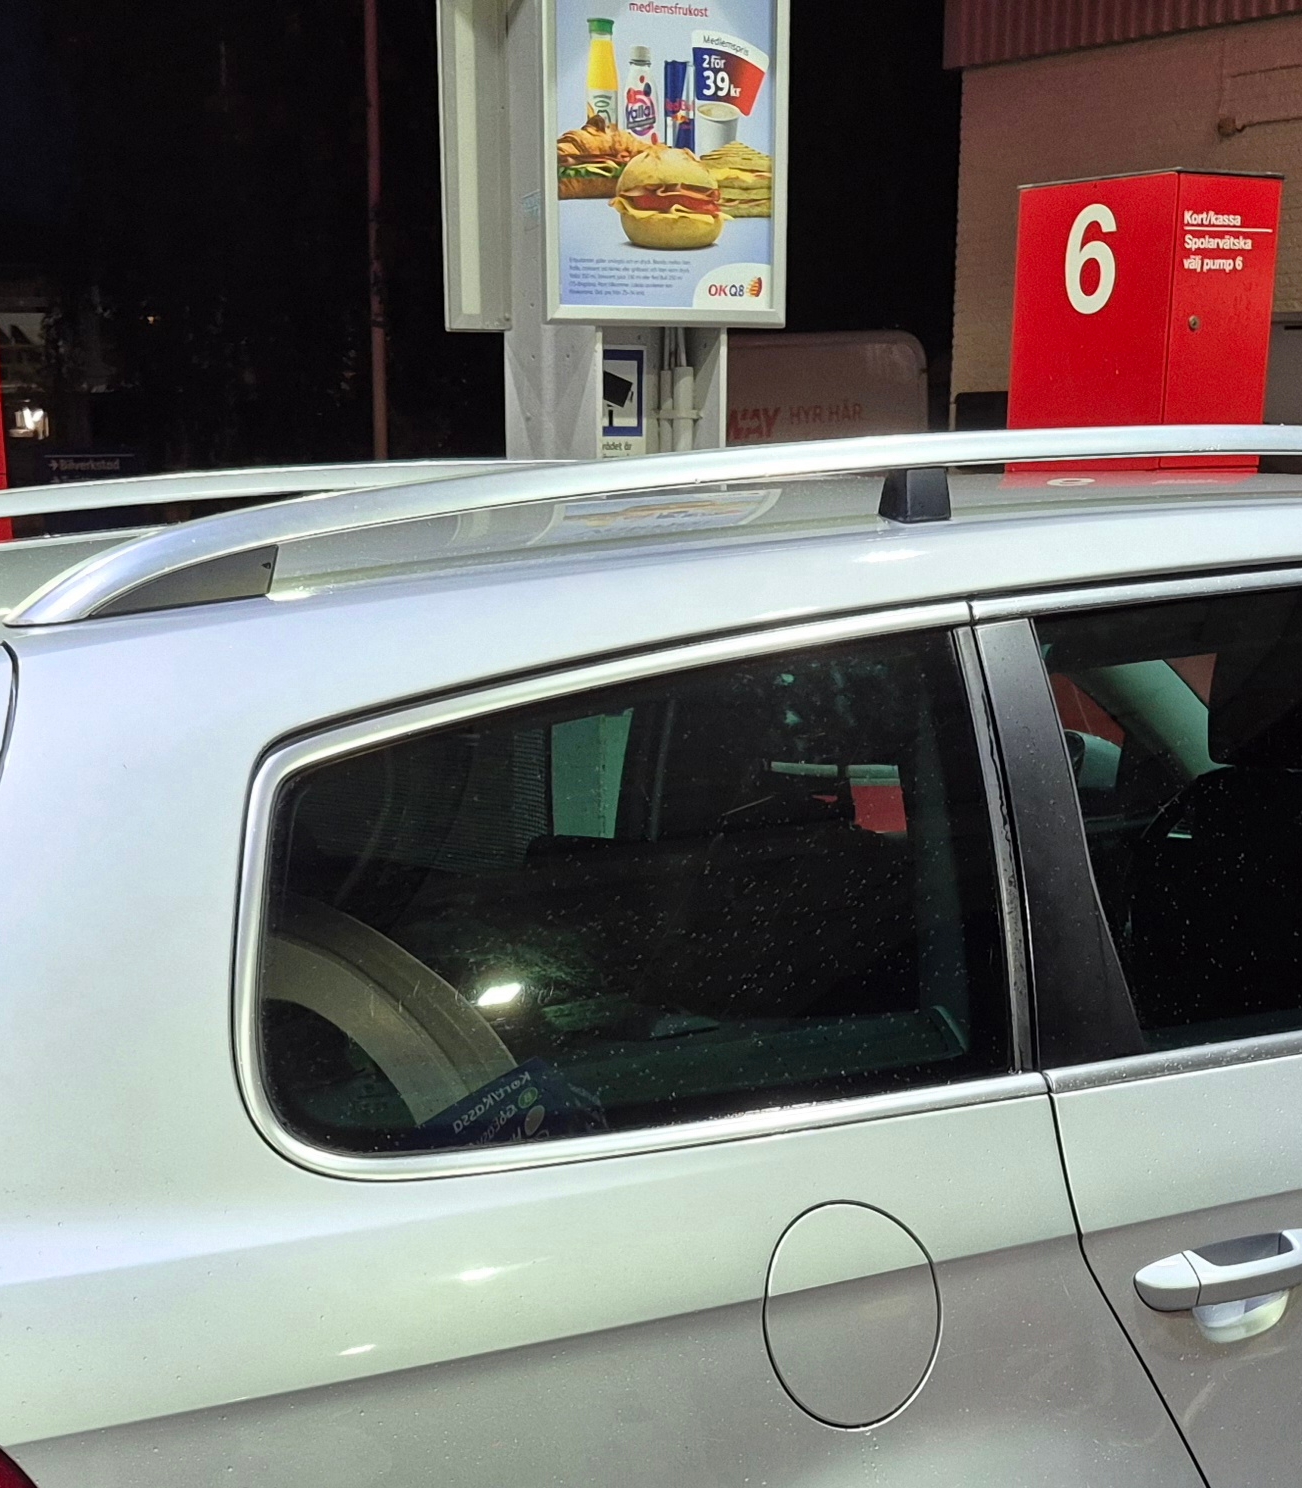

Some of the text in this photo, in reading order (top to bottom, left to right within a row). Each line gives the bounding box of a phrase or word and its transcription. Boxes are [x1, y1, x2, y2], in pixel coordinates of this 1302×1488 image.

[629, 2, 709, 18] medlemsfrukost
[703, 35, 750, 57] Medlemspris
[1183, 211, 1242, 227] Kort/kassa
[1184, 234, 1253, 251] Spolarvätska
[1064, 203, 1117, 315] 6
[1183, 255, 1244, 273] välj pump 6
